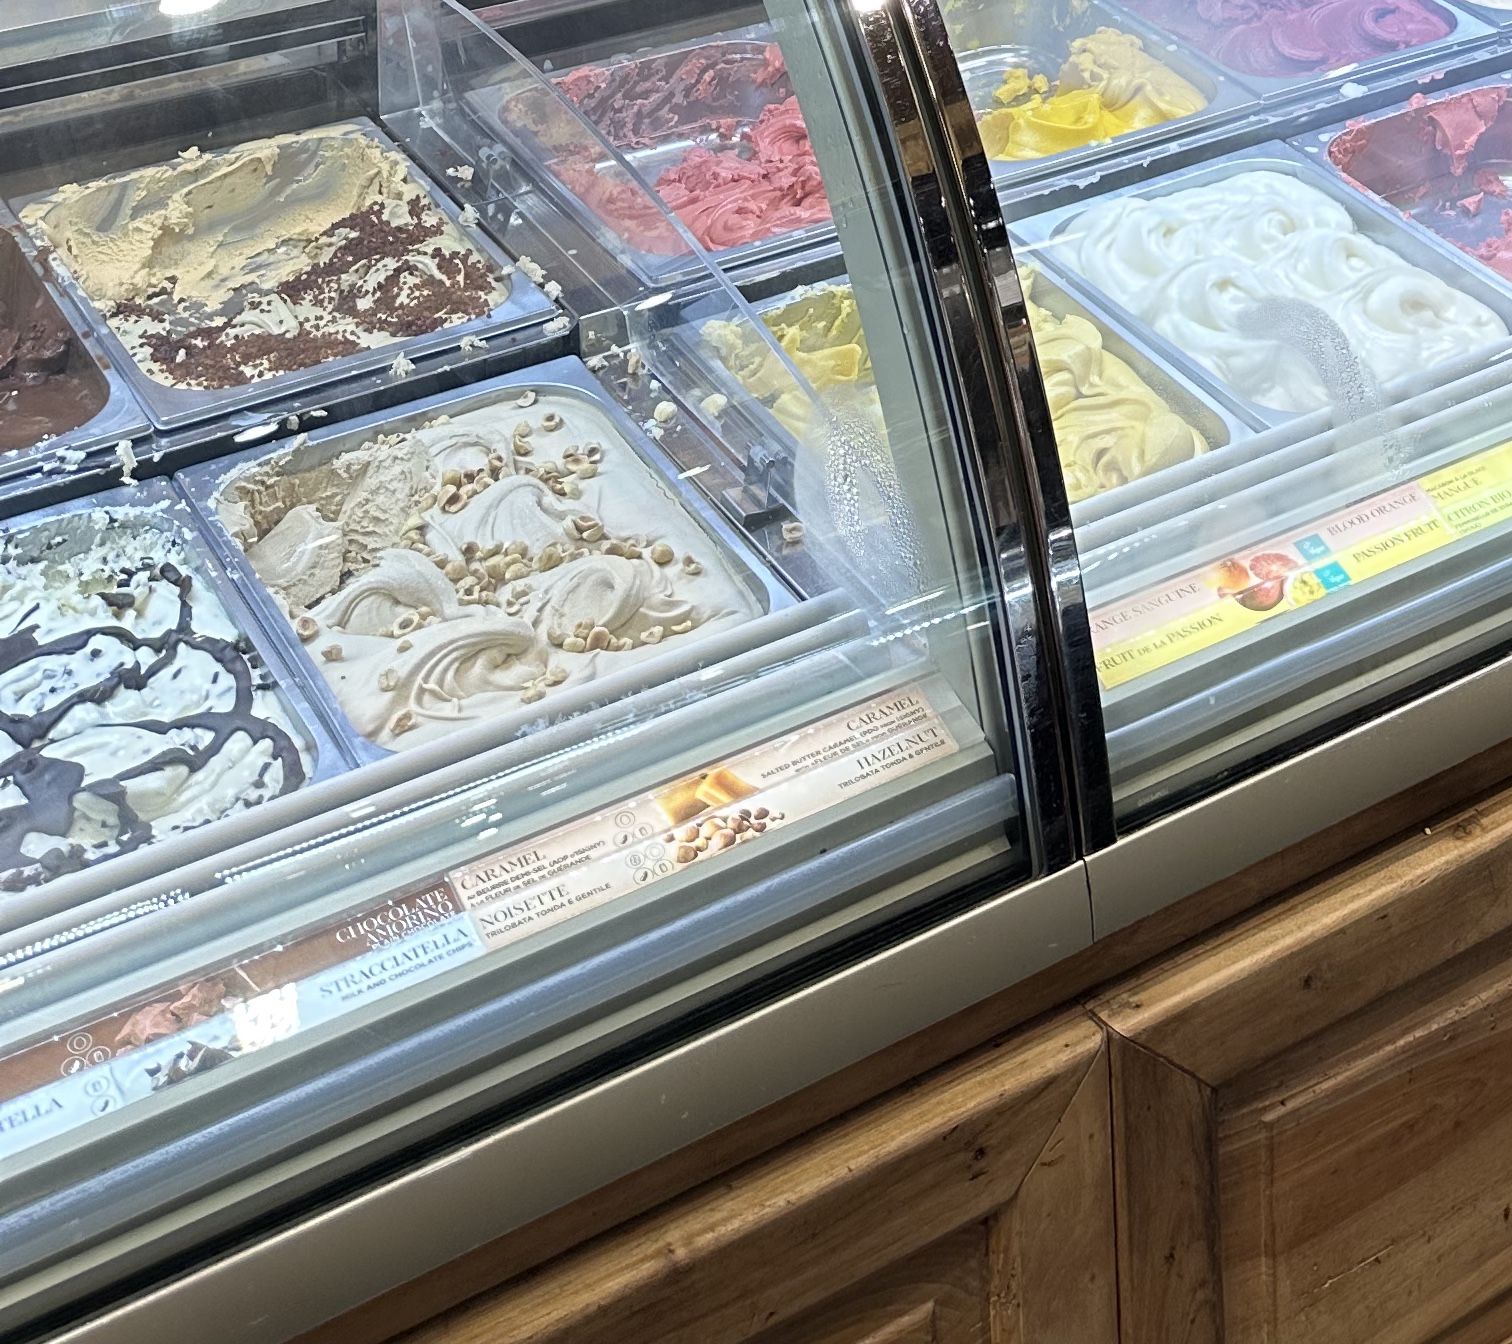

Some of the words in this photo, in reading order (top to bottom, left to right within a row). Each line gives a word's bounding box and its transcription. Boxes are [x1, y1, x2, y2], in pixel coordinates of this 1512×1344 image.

[1425, 479, 1454, 492] MACARON
[1430, 475, 1483, 501] MANGUE
[1447, 497, 1492, 522] CITRON
[1489, 489, 1512, 504] BIO
[1328, 512, 1371, 537] BLOOD
[1370, 491, 1420, 521] ORANGE
[1352, 530, 1404, 564] PASSION
[1403, 518, 1440, 544] FRUIT
[1132, 581, 1202, 617] SANGUINE
[1095, 648, 1136, 674] FRUIT
[1136, 643, 1153, 657] DE
[1153, 637, 1168, 650] LA
[1168, 611, 1225, 645] PASSION
[846, 695, 920, 732] CARAMEL
[760, 761, 791, 779] SALTED
[790, 749, 822, 767] BUTTER
[822, 733, 858, 753] CARAMEL
[837, 766, 880, 790] TRILOBATA
[879, 755, 908, 772] TONDA
[908, 752, 914, 760] &
[913, 737, 947, 758] GENTILE
[839, 745, 851, 755] DE
[855, 725, 939, 770] HAZELNUT
[460, 849, 547, 891] CARAMEL
[476, 878, 511, 897] BEURRE
[510, 863, 549, 883] DEMI-SEL
[548, 855, 570, 869] (AOP
[485, 887, 513, 904] FLEUR
[521, 877, 539, 888] SEL
[547, 853, 593, 877] GUÉRANDE
[335, 887, 448, 944] CHOCOLATE
[366, 899, 454, 947] AMORINO
[478, 883, 571, 930] NOISETTE
[485, 915, 535, 940] TRILOBATA
[534, 900, 566, 919] TONDA
[574, 881, 612, 903] GENTILE
[318, 925, 470, 999] STRACCIATELLA
[341, 985, 367, 1002] MILK
[364, 976, 389, 992] AND
[387, 953, 446, 983] CHOCOLATE
[445, 941, 476, 958] CHIPS
